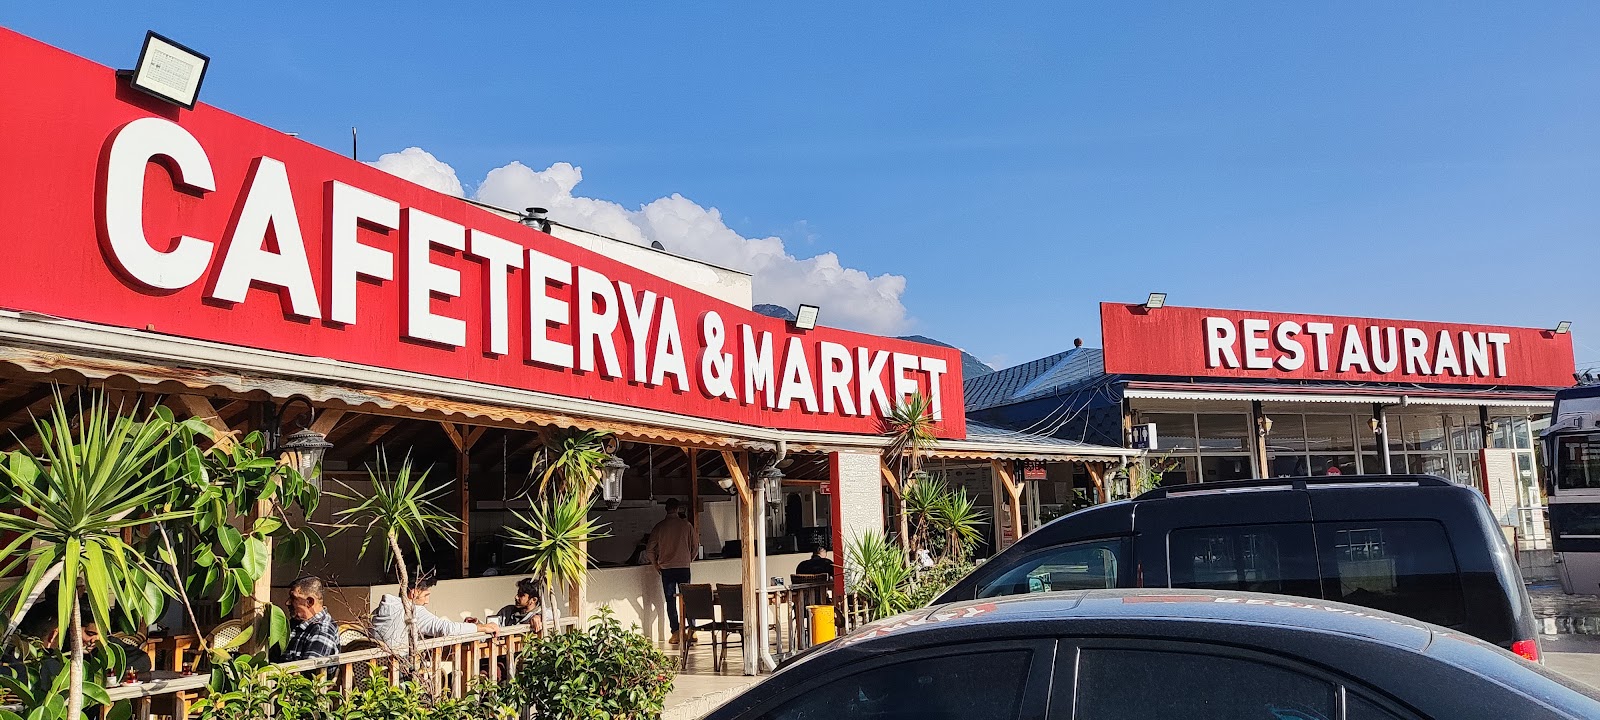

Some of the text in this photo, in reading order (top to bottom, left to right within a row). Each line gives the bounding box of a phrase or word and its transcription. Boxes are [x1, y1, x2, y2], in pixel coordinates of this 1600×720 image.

[105, 117, 948, 421] CAFETERYA & MARKET
[1206, 316, 1511, 377] RESTAURANT
